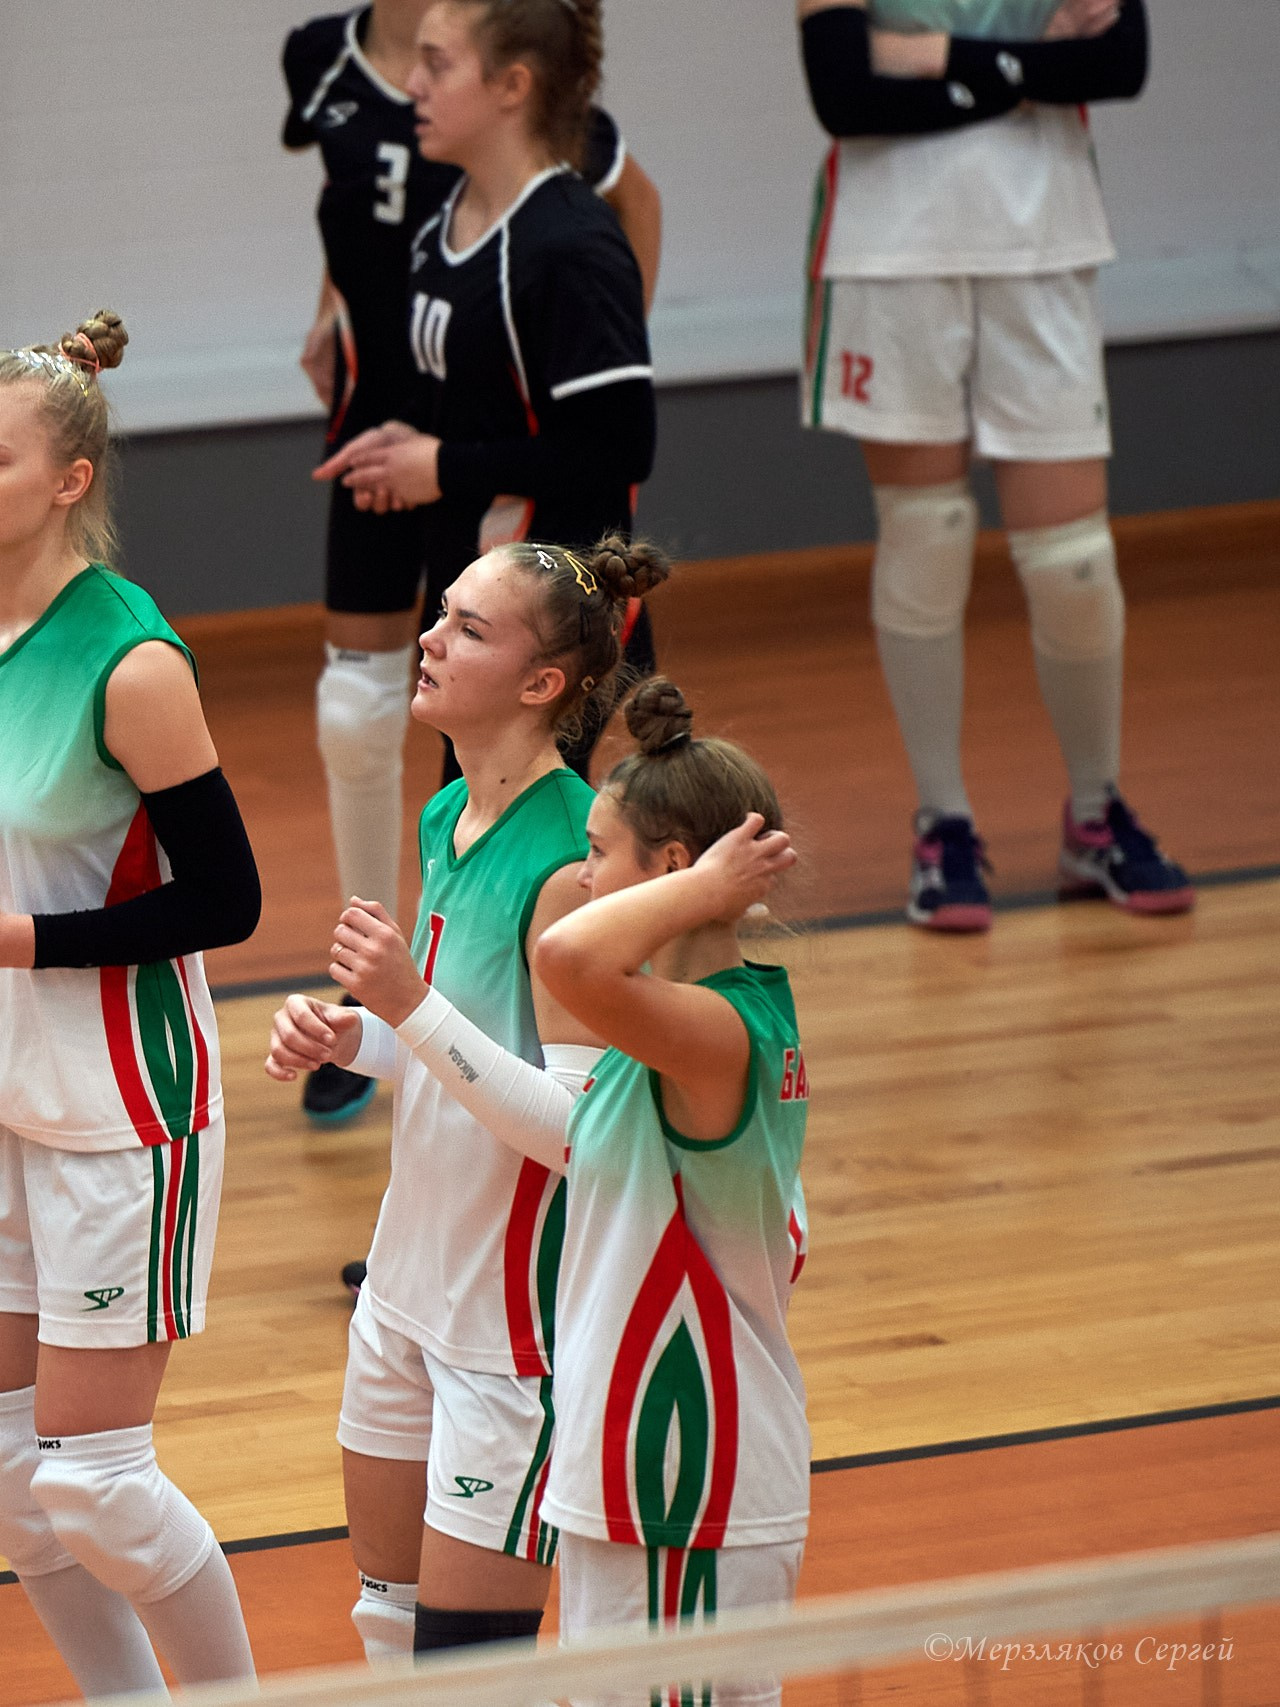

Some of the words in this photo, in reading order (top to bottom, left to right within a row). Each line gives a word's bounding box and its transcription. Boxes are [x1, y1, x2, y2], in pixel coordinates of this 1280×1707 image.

[373, 141, 410, 226] 3
[410, 291, 452, 381] 10
[840, 350, 874, 405] 12
[423, 911, 446, 986] 1
